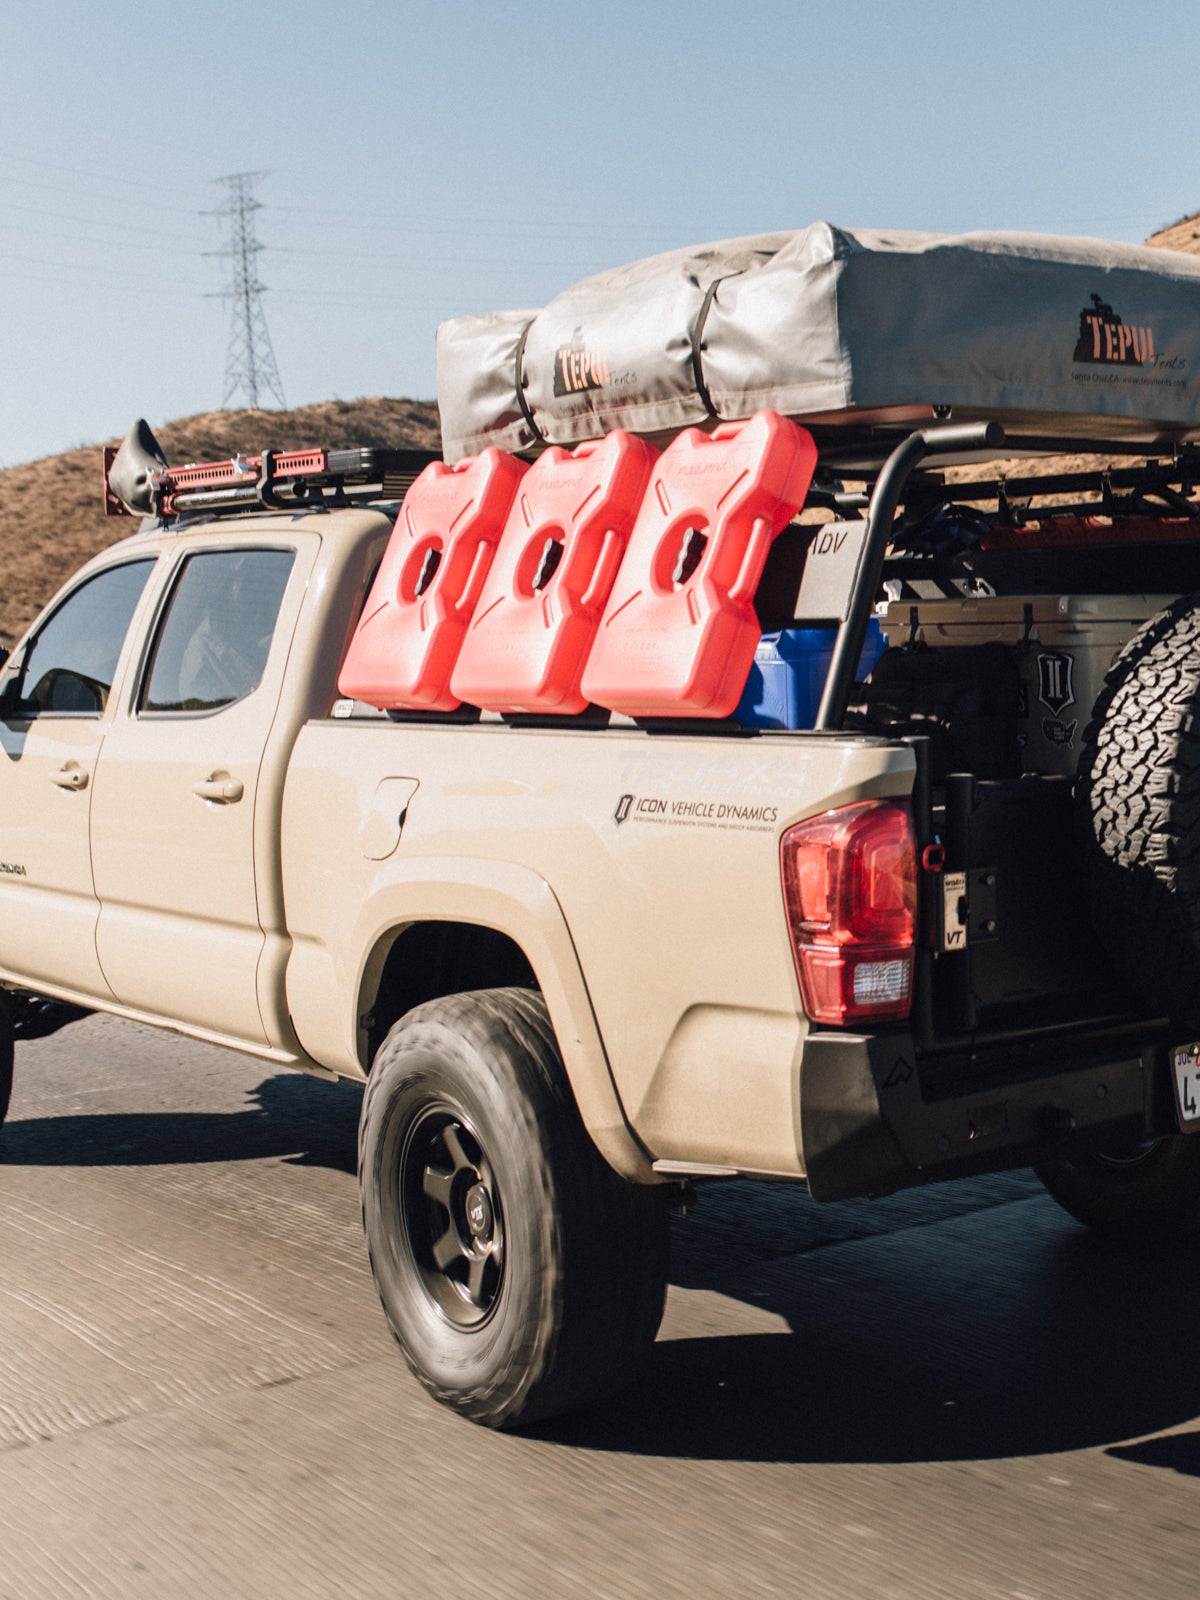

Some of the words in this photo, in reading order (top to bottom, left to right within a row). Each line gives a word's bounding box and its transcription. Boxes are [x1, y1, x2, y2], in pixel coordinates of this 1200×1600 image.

[1086, 315, 1155, 364] TEPUI
[636, 798, 668, 814] ICON
[671, 800, 715, 818] VEHICLE
[717, 804, 778, 823] DYNAMICS
